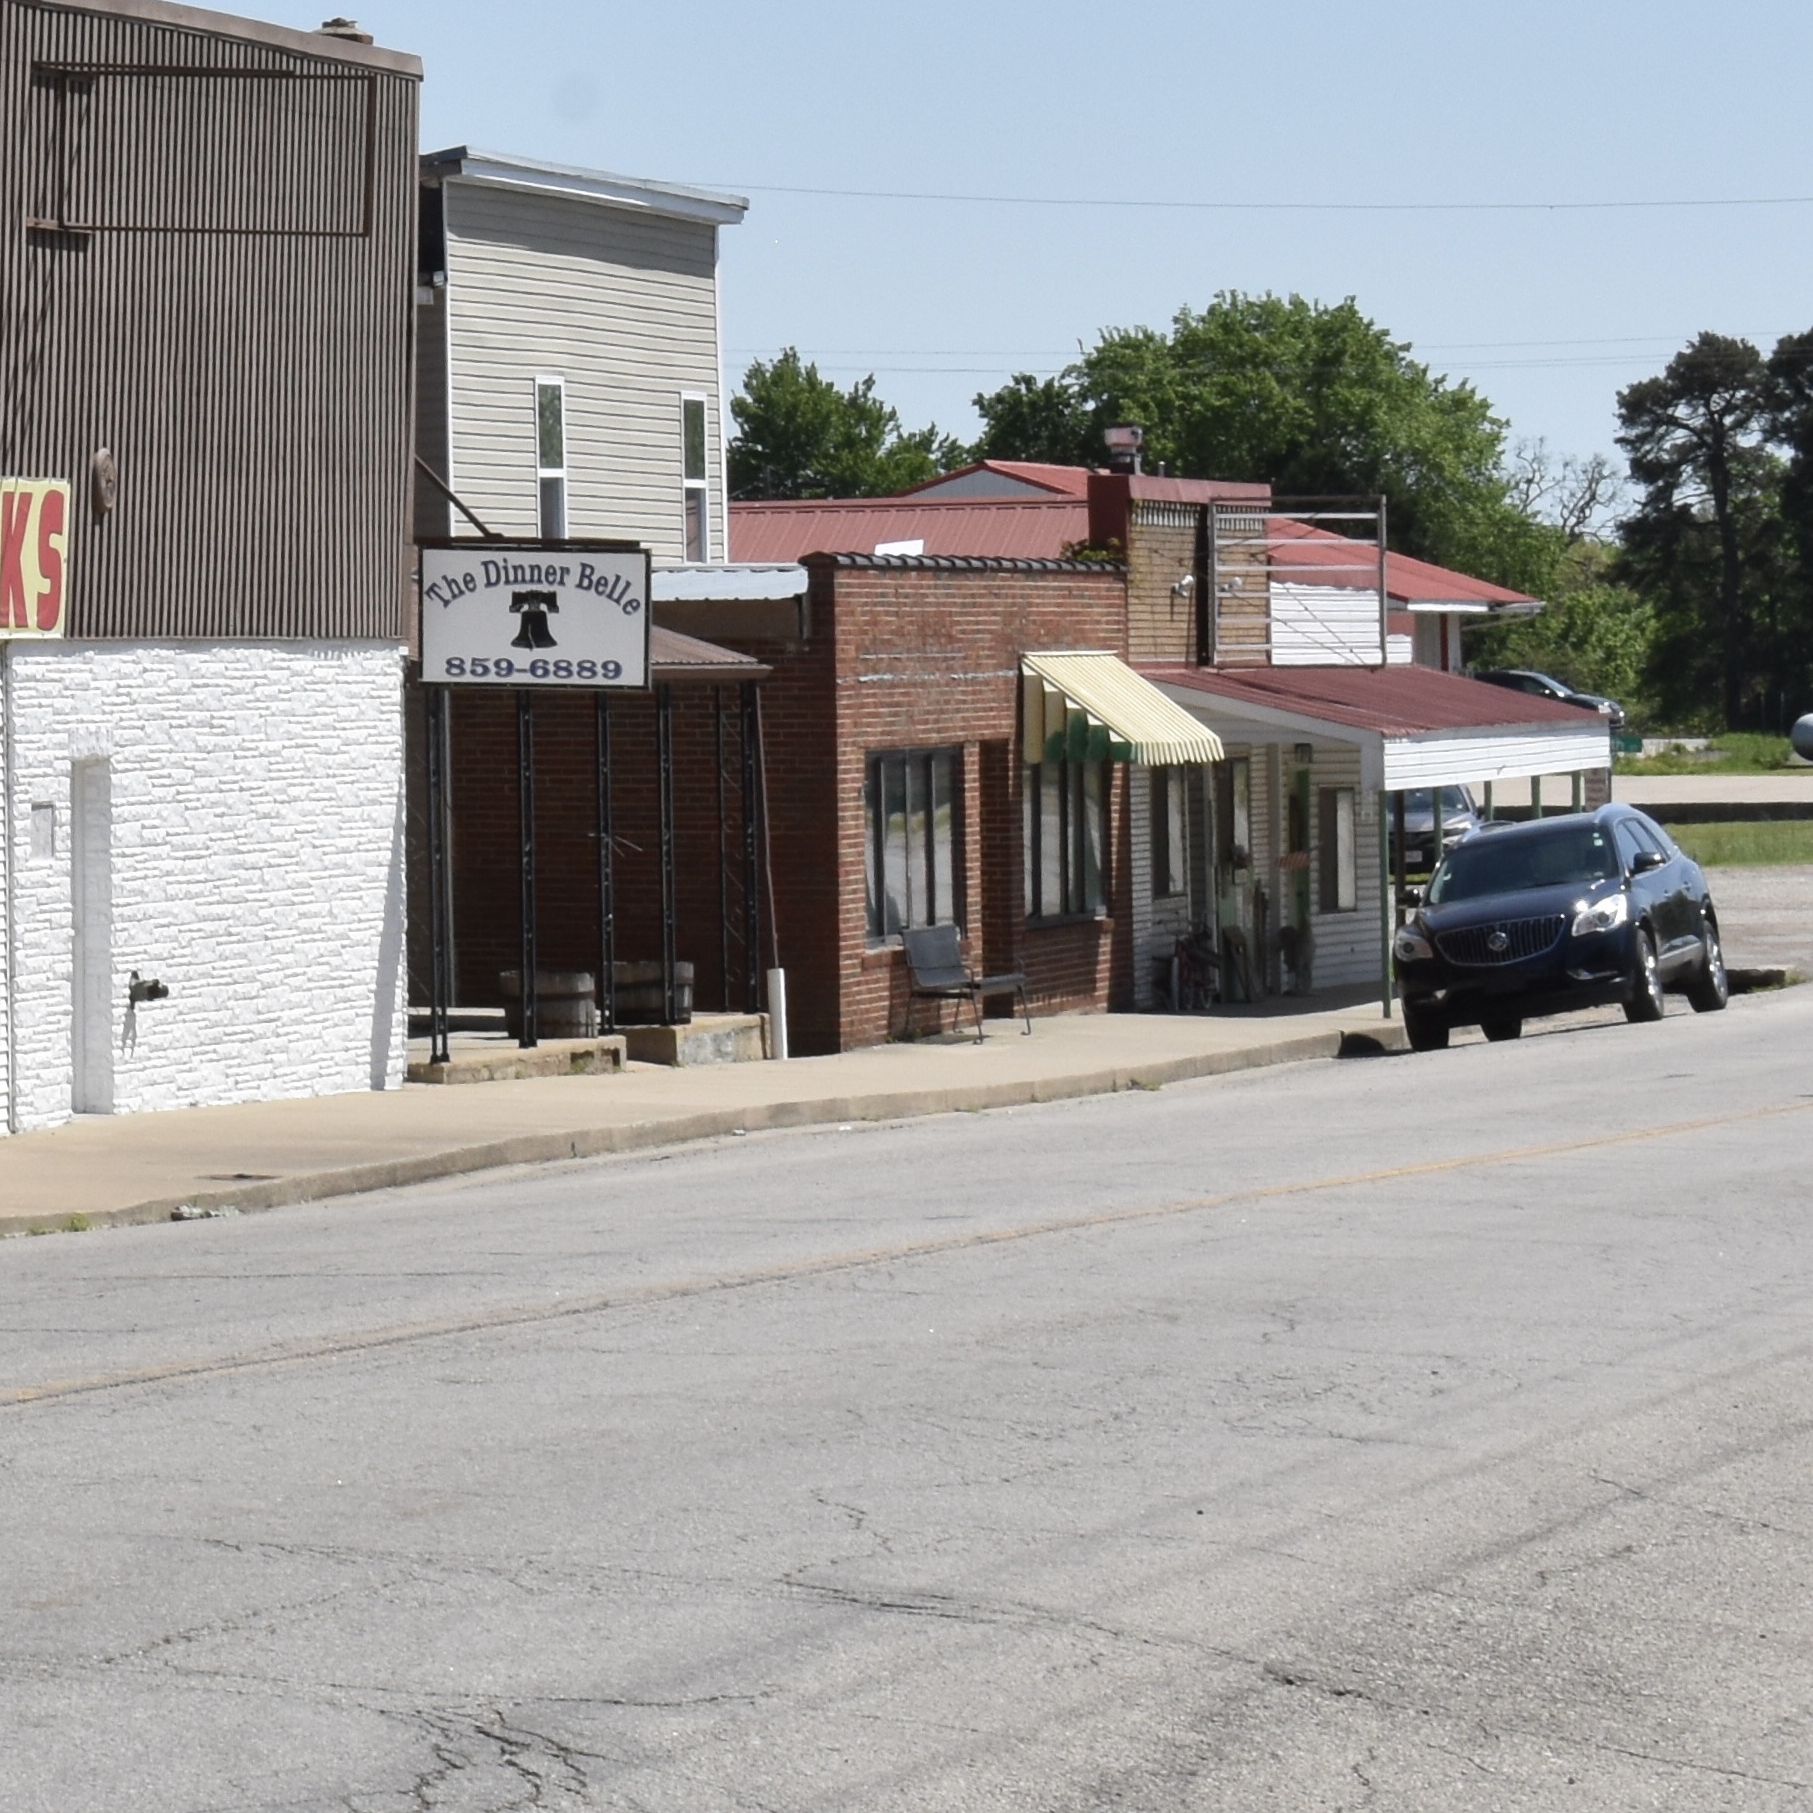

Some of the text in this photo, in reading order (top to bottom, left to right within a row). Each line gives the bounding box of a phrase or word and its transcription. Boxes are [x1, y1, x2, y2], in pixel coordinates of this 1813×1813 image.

[425, 557, 642, 616] The Dinner Belle
[444, 656, 624, 680] 859-6889
